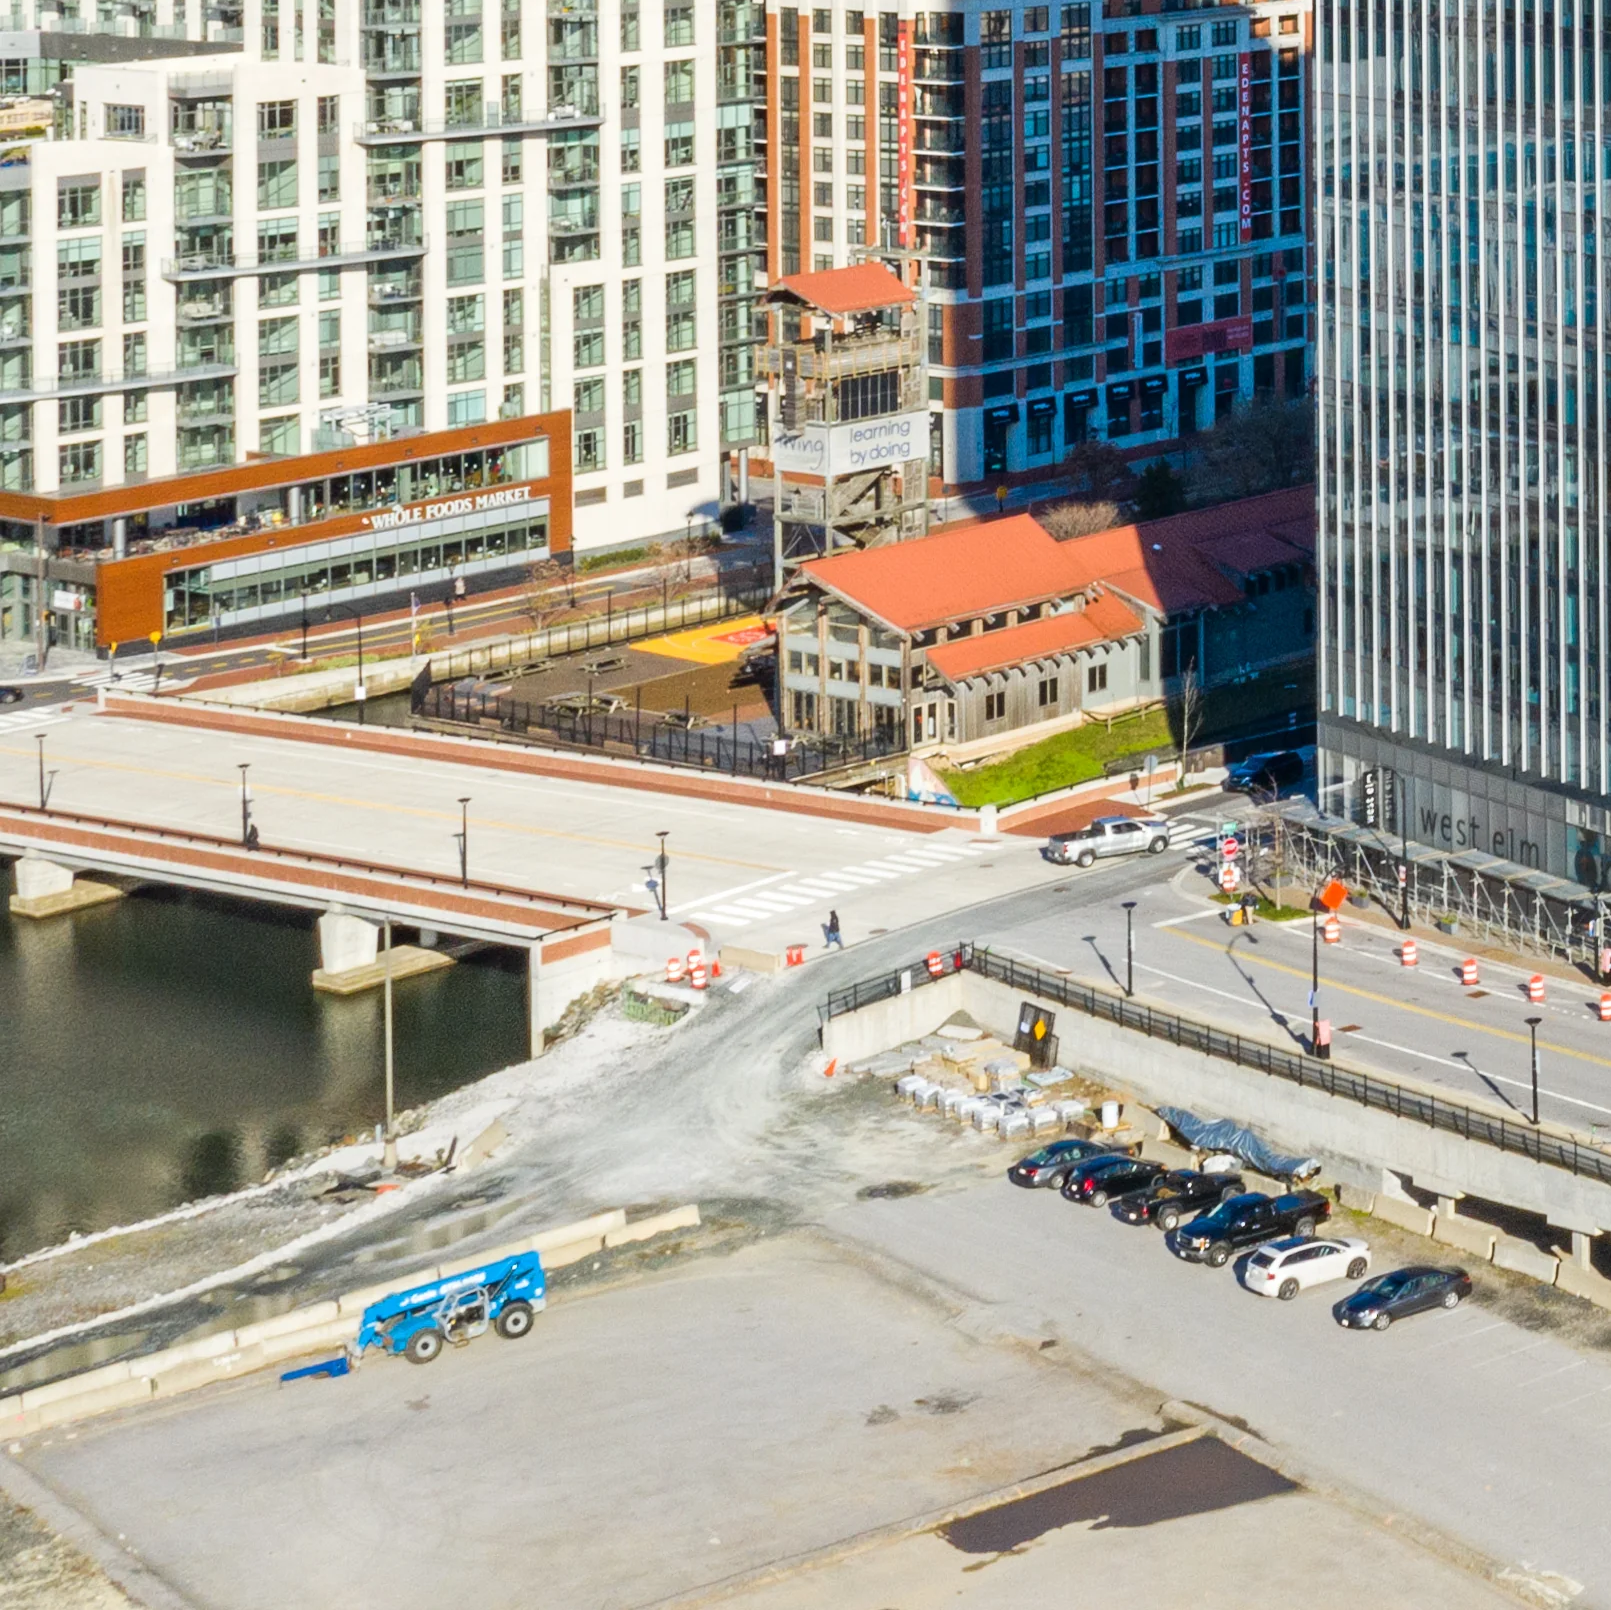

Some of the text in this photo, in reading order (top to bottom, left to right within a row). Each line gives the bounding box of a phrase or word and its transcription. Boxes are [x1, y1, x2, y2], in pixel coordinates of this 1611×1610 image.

[1242, 63, 1251, 229] EDENAPTS.COM
[850, 420, 911, 442] learning
[850, 441, 911, 467] by doing
[370, 486, 532, 529] WHOLE FOODS MARKET
[1420, 807, 1540, 870] west elm
